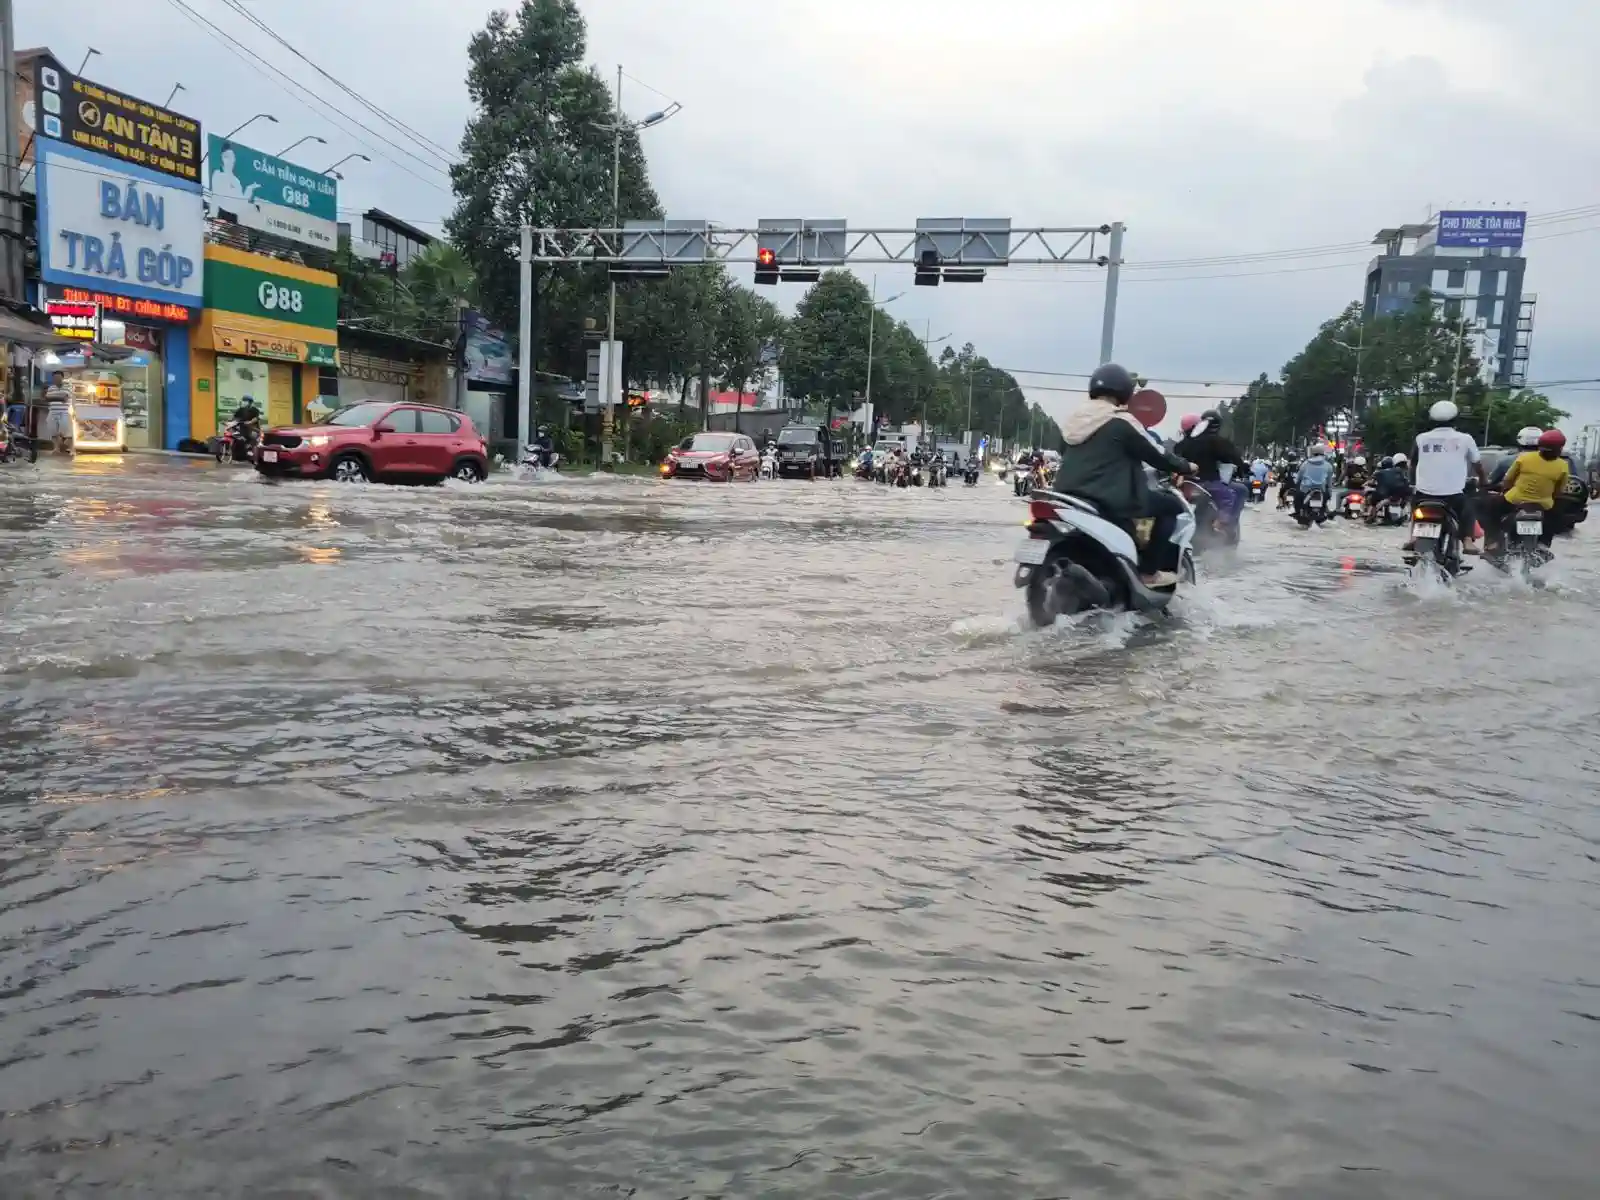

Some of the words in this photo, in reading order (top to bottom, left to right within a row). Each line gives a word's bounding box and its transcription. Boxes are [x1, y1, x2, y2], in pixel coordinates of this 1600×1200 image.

[103, 112, 135, 141] AN
[138, 123, 179, 154] TÂN
[180, 139, 194, 160] 3
[100, 180, 165, 231] BÁN
[283, 186, 310, 208] F88
[1442, 217, 1460, 229] CHO
[1461, 215, 1485, 229] THUÊ
[1503, 215, 1521, 229] NHÀ
[60, 229, 128, 279] TRẢ
[137, 243, 194, 289] GÓP
[258, 281, 303, 313] F88
[244, 338, 259, 356] 15
